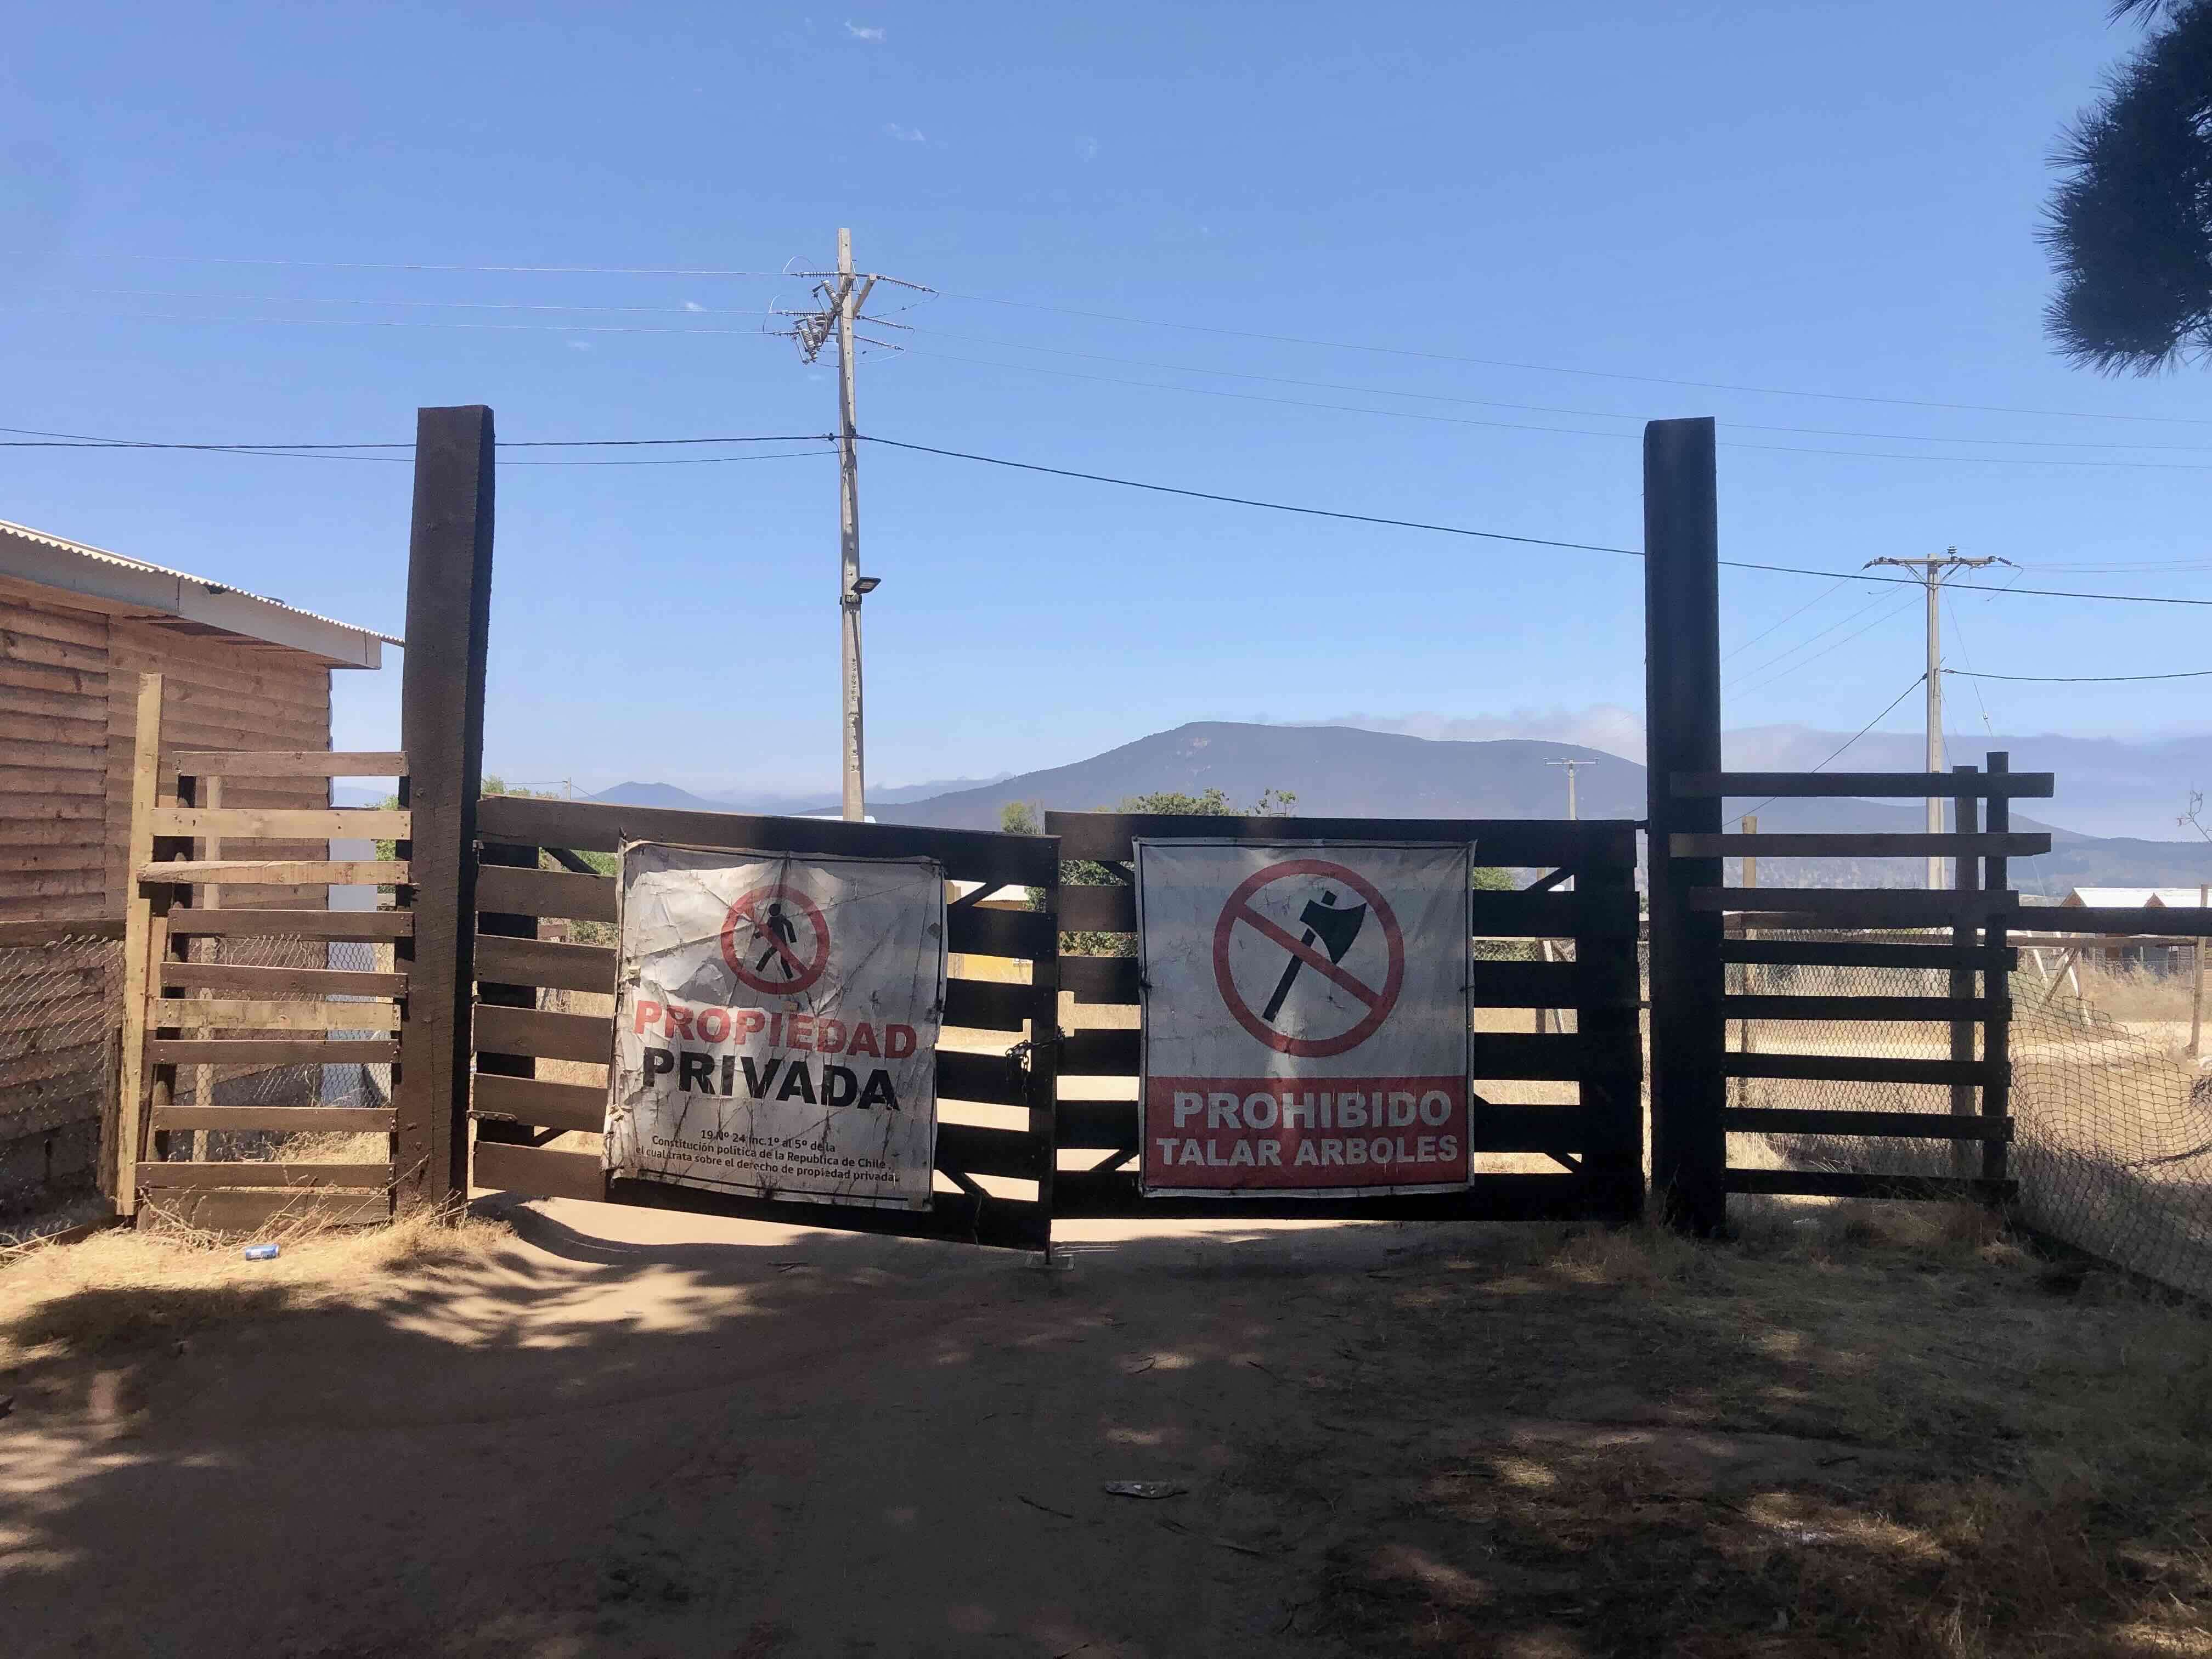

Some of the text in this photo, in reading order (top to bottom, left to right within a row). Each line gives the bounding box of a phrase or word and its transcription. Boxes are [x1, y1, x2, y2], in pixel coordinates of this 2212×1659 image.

[634, 1000, 917, 1059] PROPIEDAD
[643, 1046, 901, 1111] PRIVADA
[1173, 1091, 1453, 1128] PROHIBIDO
[652, 1135, 714, 1153] Constitución
[716, 1145, 757, 1158] política
[759, 1149, 772, 1159] de
[775, 1150, 785, 1160] la
[787, 1152, 839, 1165] Republica
[842, 1157, 855, 1167] de
[701, 1129, 714, 1140] 19
[732, 1132, 747, 1143] 24
[782, 1139, 792, 1148] al
[810, 1141, 823, 1152] de
[825, 1143, 836, 1153] la
[1156, 1135, 1458, 1166] TALAR ARBOLES
[636, 1146, 644, 1154] el
[646, 1148, 665, 1159] cual
[667, 1151, 692, 1162] trata
[695, 1155, 723, 1166] sobre
[725, 1158, 734, 1167] el
[737, 1159, 778, 1172] derecho
[781, 1164, 794, 1174] de
[797, 1166, 851, 1179] propiedad
